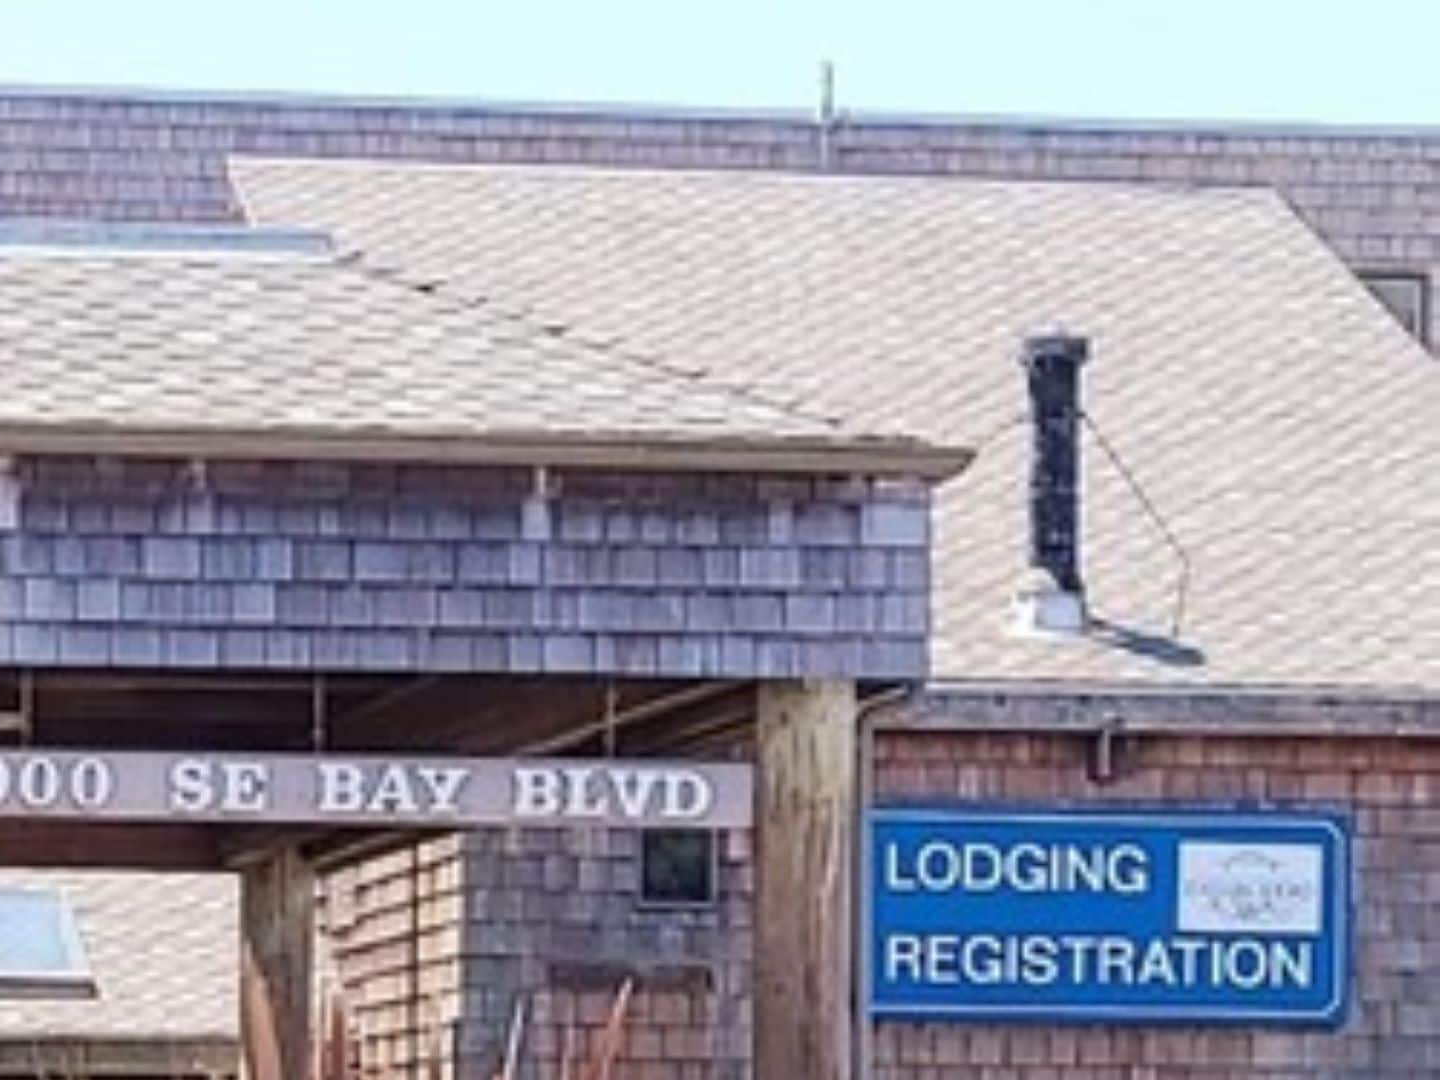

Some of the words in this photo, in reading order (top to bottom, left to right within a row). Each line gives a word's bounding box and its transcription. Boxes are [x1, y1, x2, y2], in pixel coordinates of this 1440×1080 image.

[170, 760, 269, 812] SE
[316, 762, 469, 815] BAY
[514, 768, 713, 819] BLVD
[885, 842, 1150, 892] LODGING
[884, 935, 1312, 988] REGISTRATION
